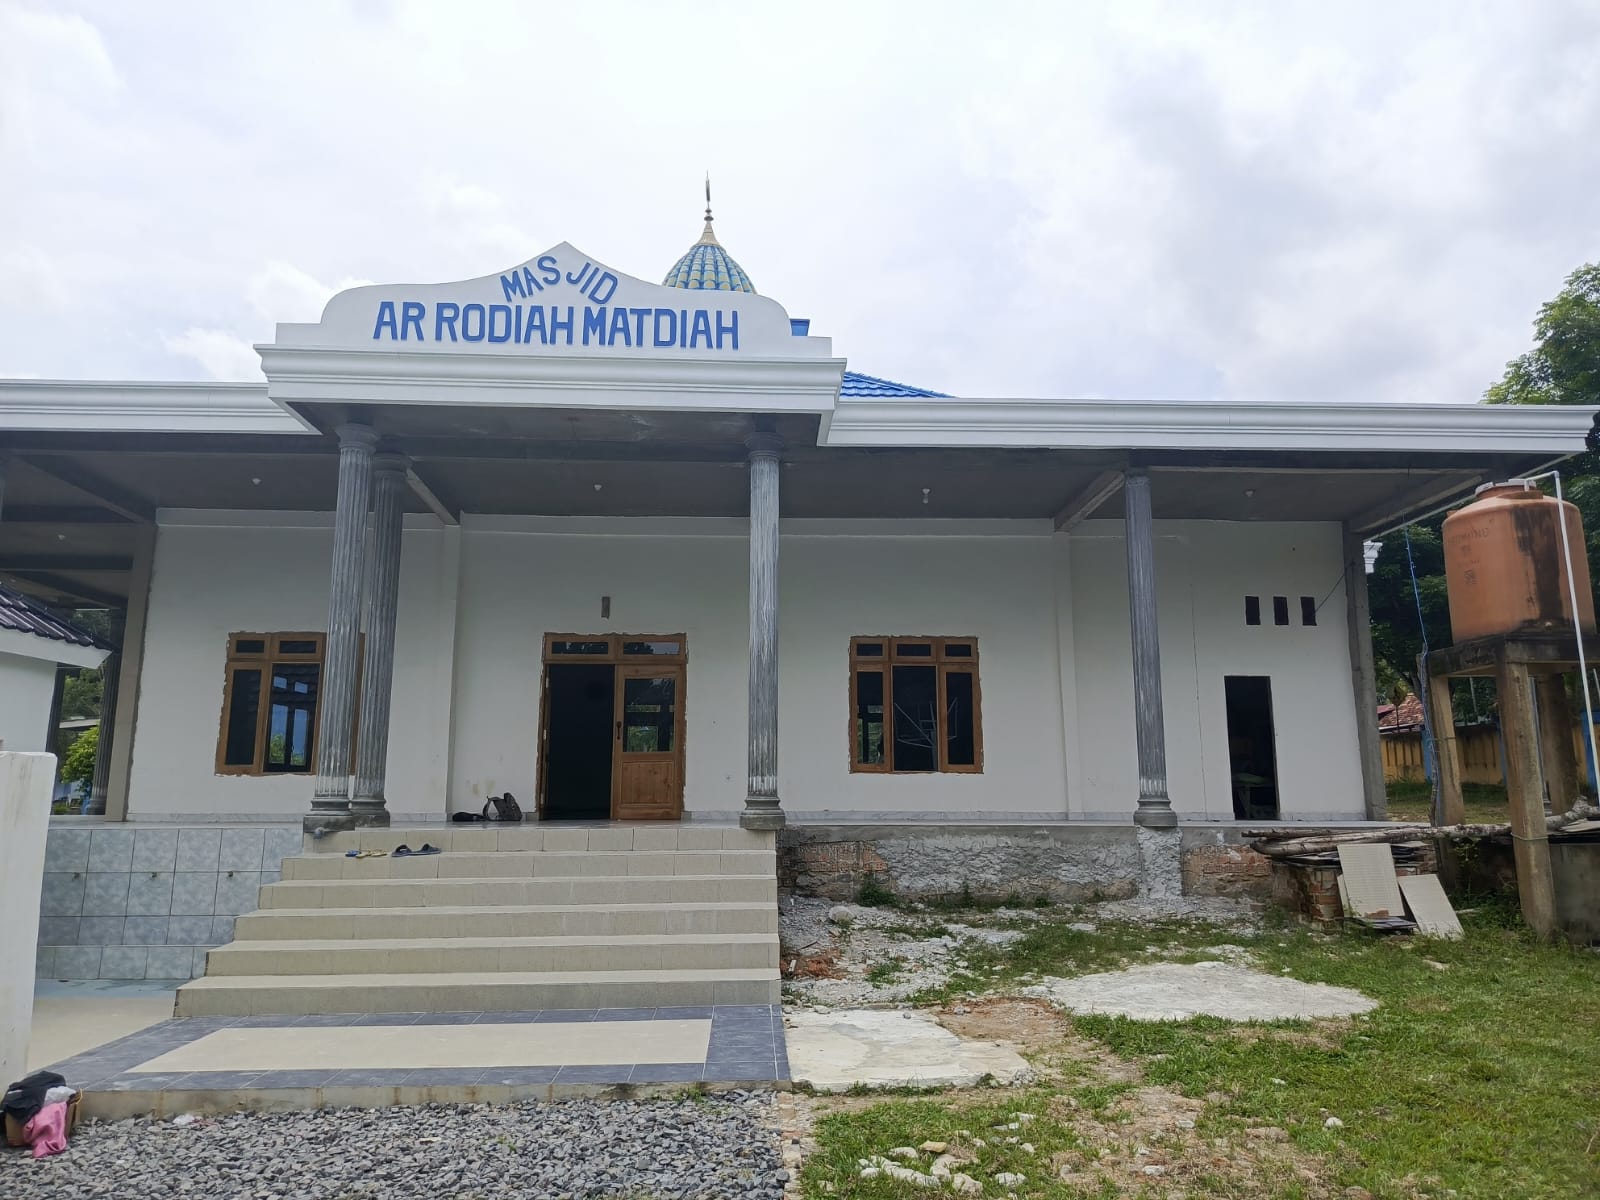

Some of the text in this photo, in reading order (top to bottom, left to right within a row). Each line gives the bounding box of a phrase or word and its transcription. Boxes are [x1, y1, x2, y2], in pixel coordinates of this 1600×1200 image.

[501, 256, 618, 305] MASJID
[373, 301, 739, 350] AR RODIAH MATDIAH
